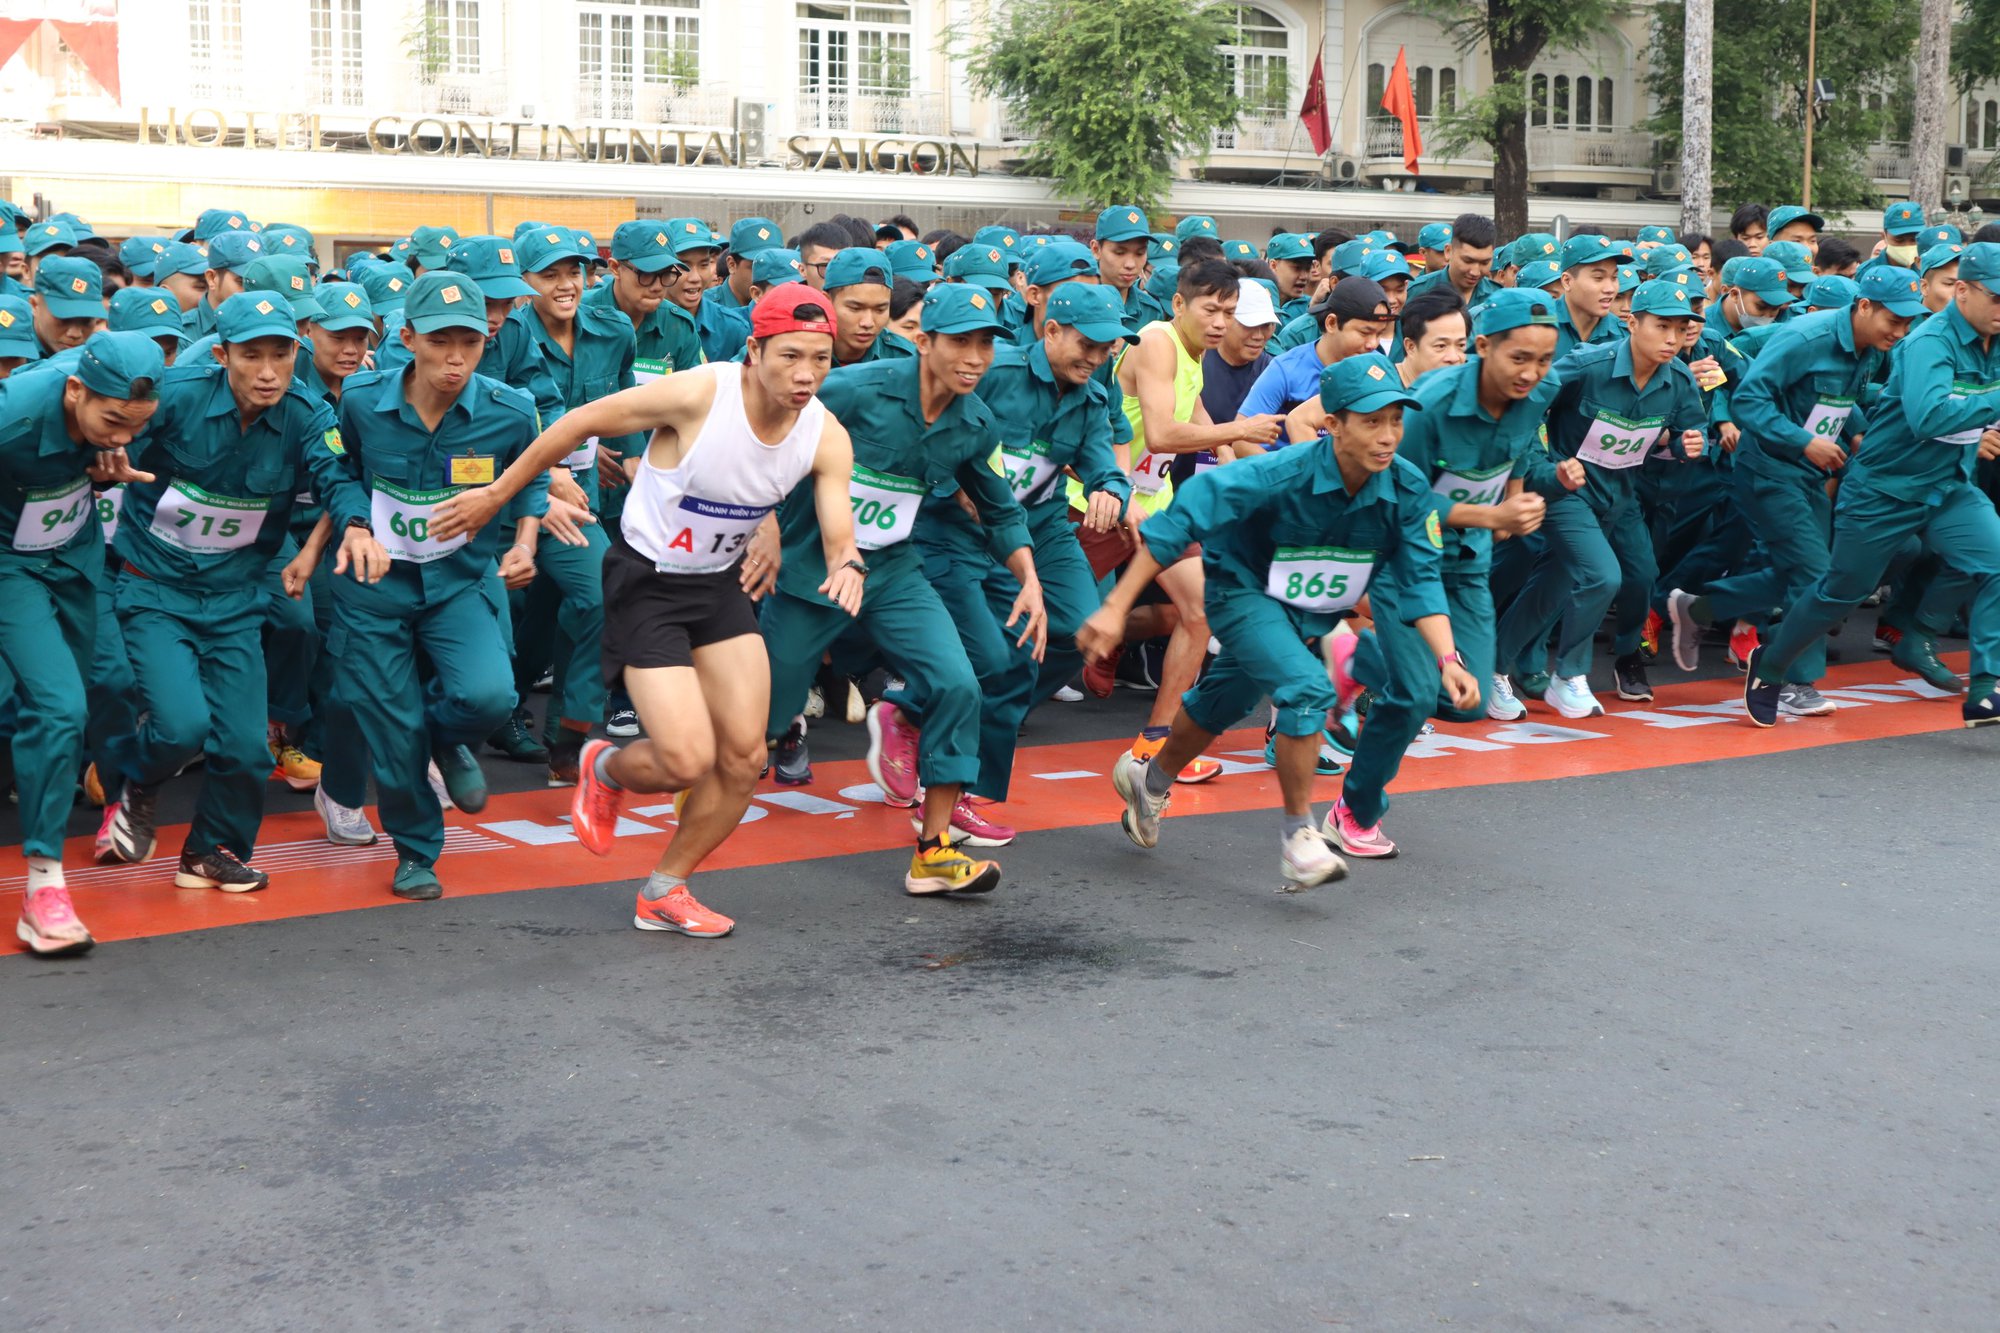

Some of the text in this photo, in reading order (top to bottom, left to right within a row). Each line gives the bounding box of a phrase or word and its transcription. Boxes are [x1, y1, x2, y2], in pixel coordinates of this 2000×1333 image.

[137, 106, 980, 178] HOTEL CONTINENTAL SAIGON
[1816, 415, 1848, 436] 687
[1600, 433, 1645, 455] 924
[1135, 454, 1153, 475] A
[42, 492, 91, 534] 947
[175, 507, 242, 538] 715
[697, 502, 728, 517] THANH
[850, 495, 898, 531] 706
[668, 526, 693, 554] A
[1285, 571, 1350, 600] 865
